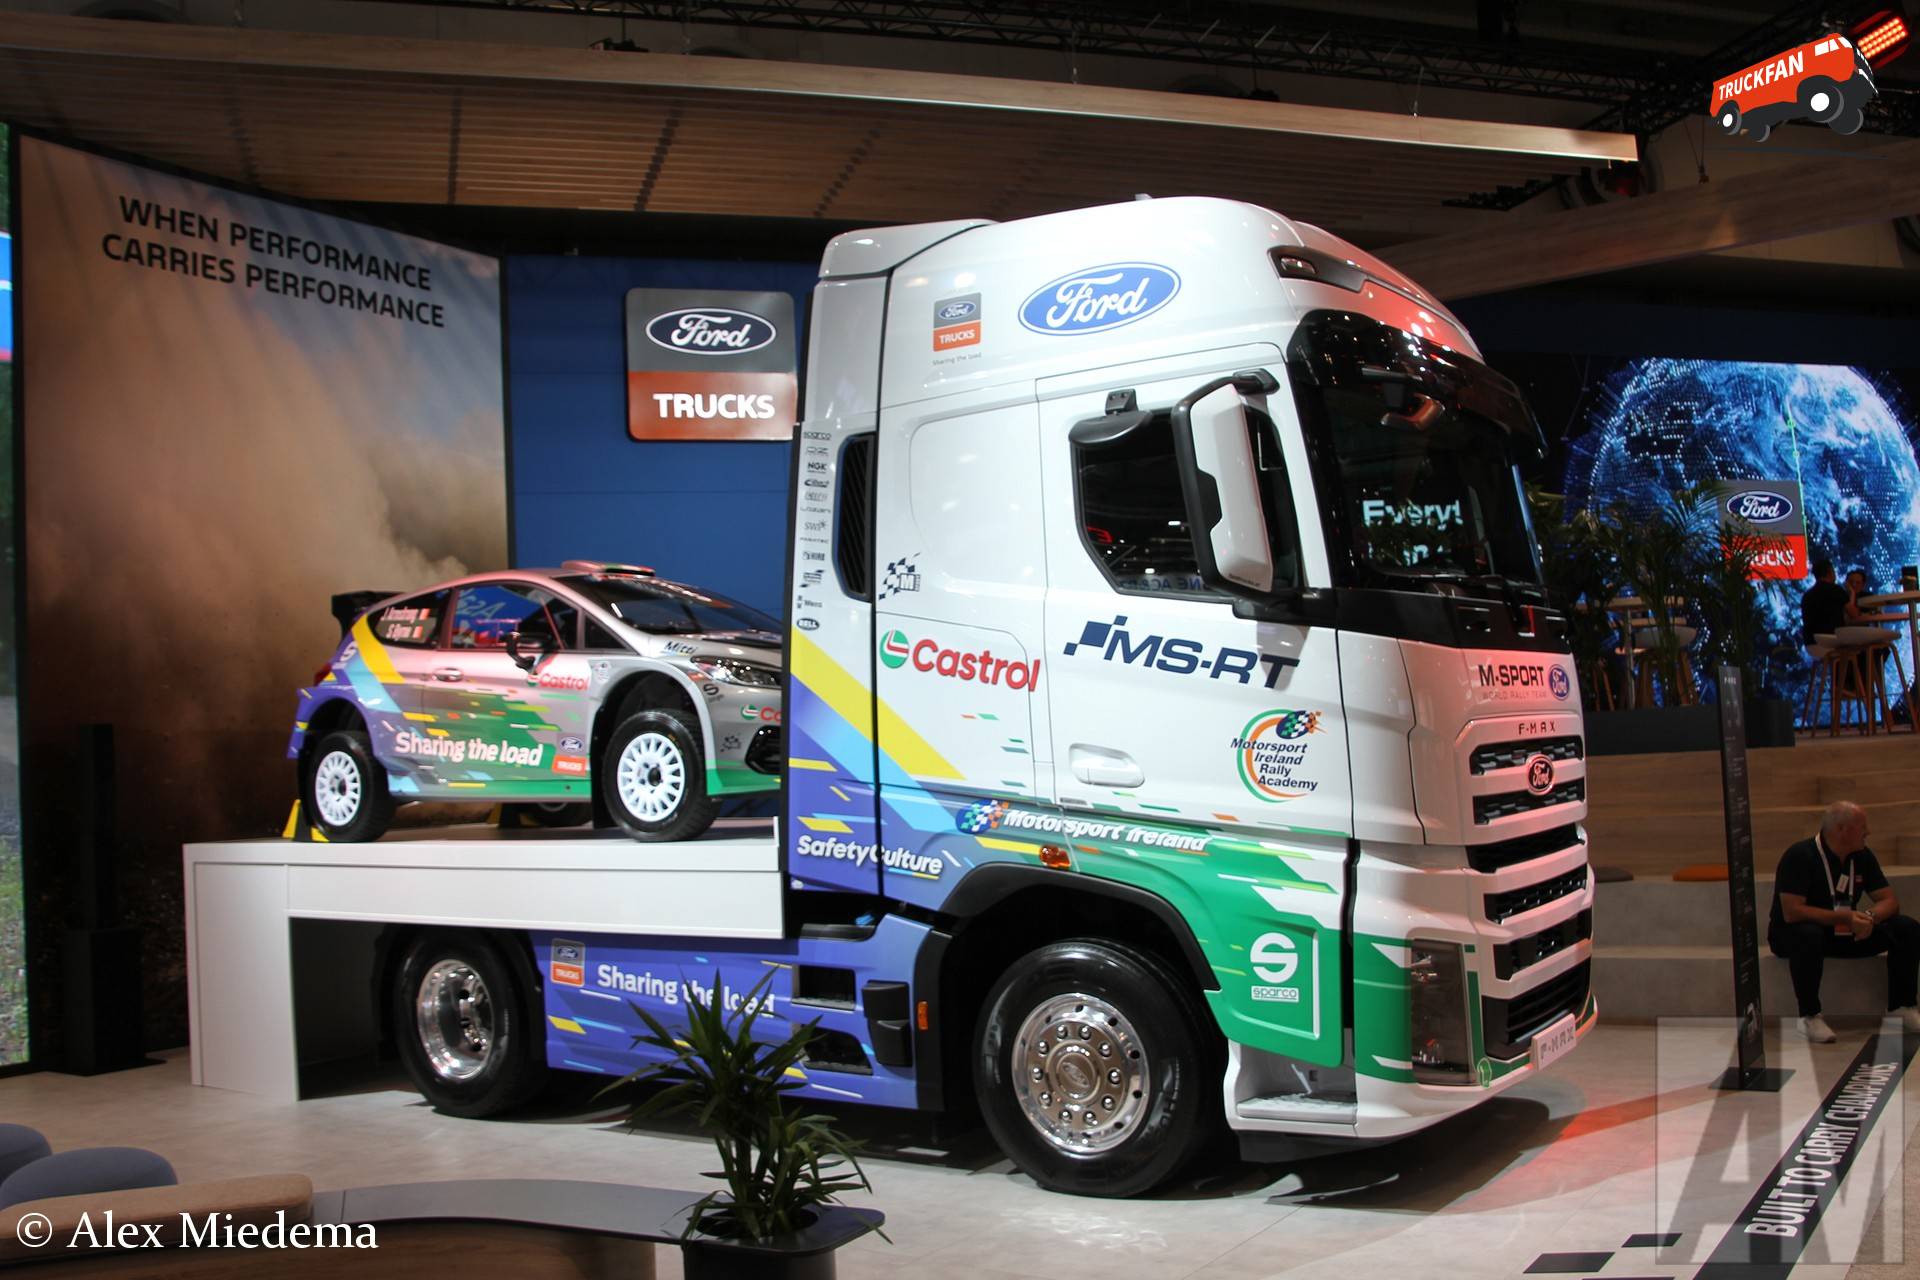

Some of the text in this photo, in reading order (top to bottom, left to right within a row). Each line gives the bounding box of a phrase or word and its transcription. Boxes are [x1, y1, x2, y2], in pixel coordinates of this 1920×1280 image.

[120, 197, 431, 291] WHEN PERFORMANCE
[102, 233, 444, 327] CARRIES PERFORMANCE
[1046, 272, 1149, 328] Ford
[671, 314, 751, 347] Ford
[939, 329, 976, 344] TRUCKS
[652, 393, 776, 419] TRUCKS
[807, 462, 827, 471] NGK
[1740, 496, 1780, 517] Ford
[912, 639, 1041, 692] Castrol
[1103, 630, 1300, 689] MS-RT
[538, 672, 590, 691] Castrol
[1478, 665, 1544, 687] M-SPORT
[395, 732, 543, 766] Sharing the load
[1230, 738, 1308, 754] Motorsport
[1254, 752, 1304, 765] Ireland
[1257, 775, 1318, 791] Academy
[1260, 763, 1291, 777] Rally
[1003, 809, 1210, 852] Motorsport Ireland
[796, 834, 943, 876] SafetyCulture
[597, 963, 679, 1004] Sharing
[1252, 987, 1298, 1000] sparco
[1795, 1122, 1859, 1165] CARRY
[1777, 1167, 1832, 1186] TO
[1744, 1188, 1819, 1237] BUILT
